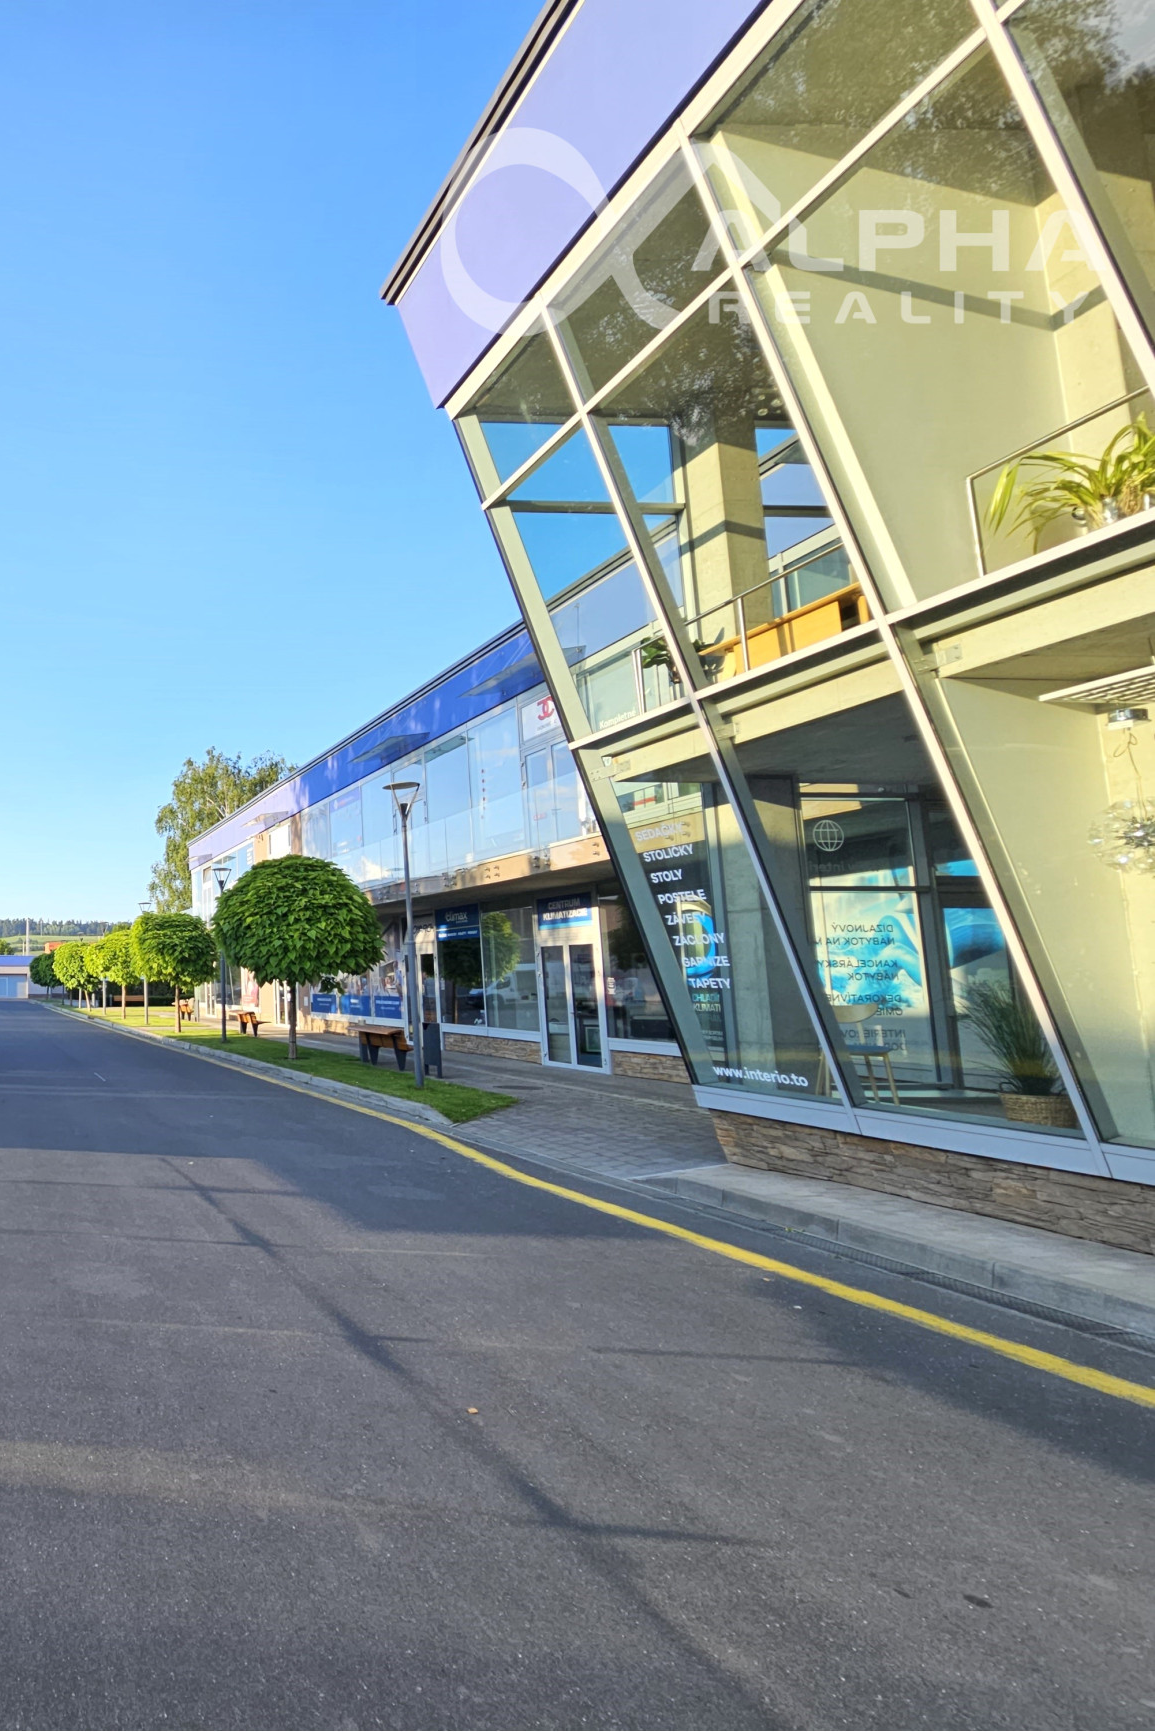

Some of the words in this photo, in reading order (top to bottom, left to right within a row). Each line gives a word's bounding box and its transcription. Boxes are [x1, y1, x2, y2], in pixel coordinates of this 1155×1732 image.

[650, 869, 683, 884] STOLY
[548, 898, 581, 911] CENTRUM
[657, 889, 707, 905] POSTELE
[687, 977, 731, 989] TAPETY
[712, 1065, 809, 1087] www.interio.to
